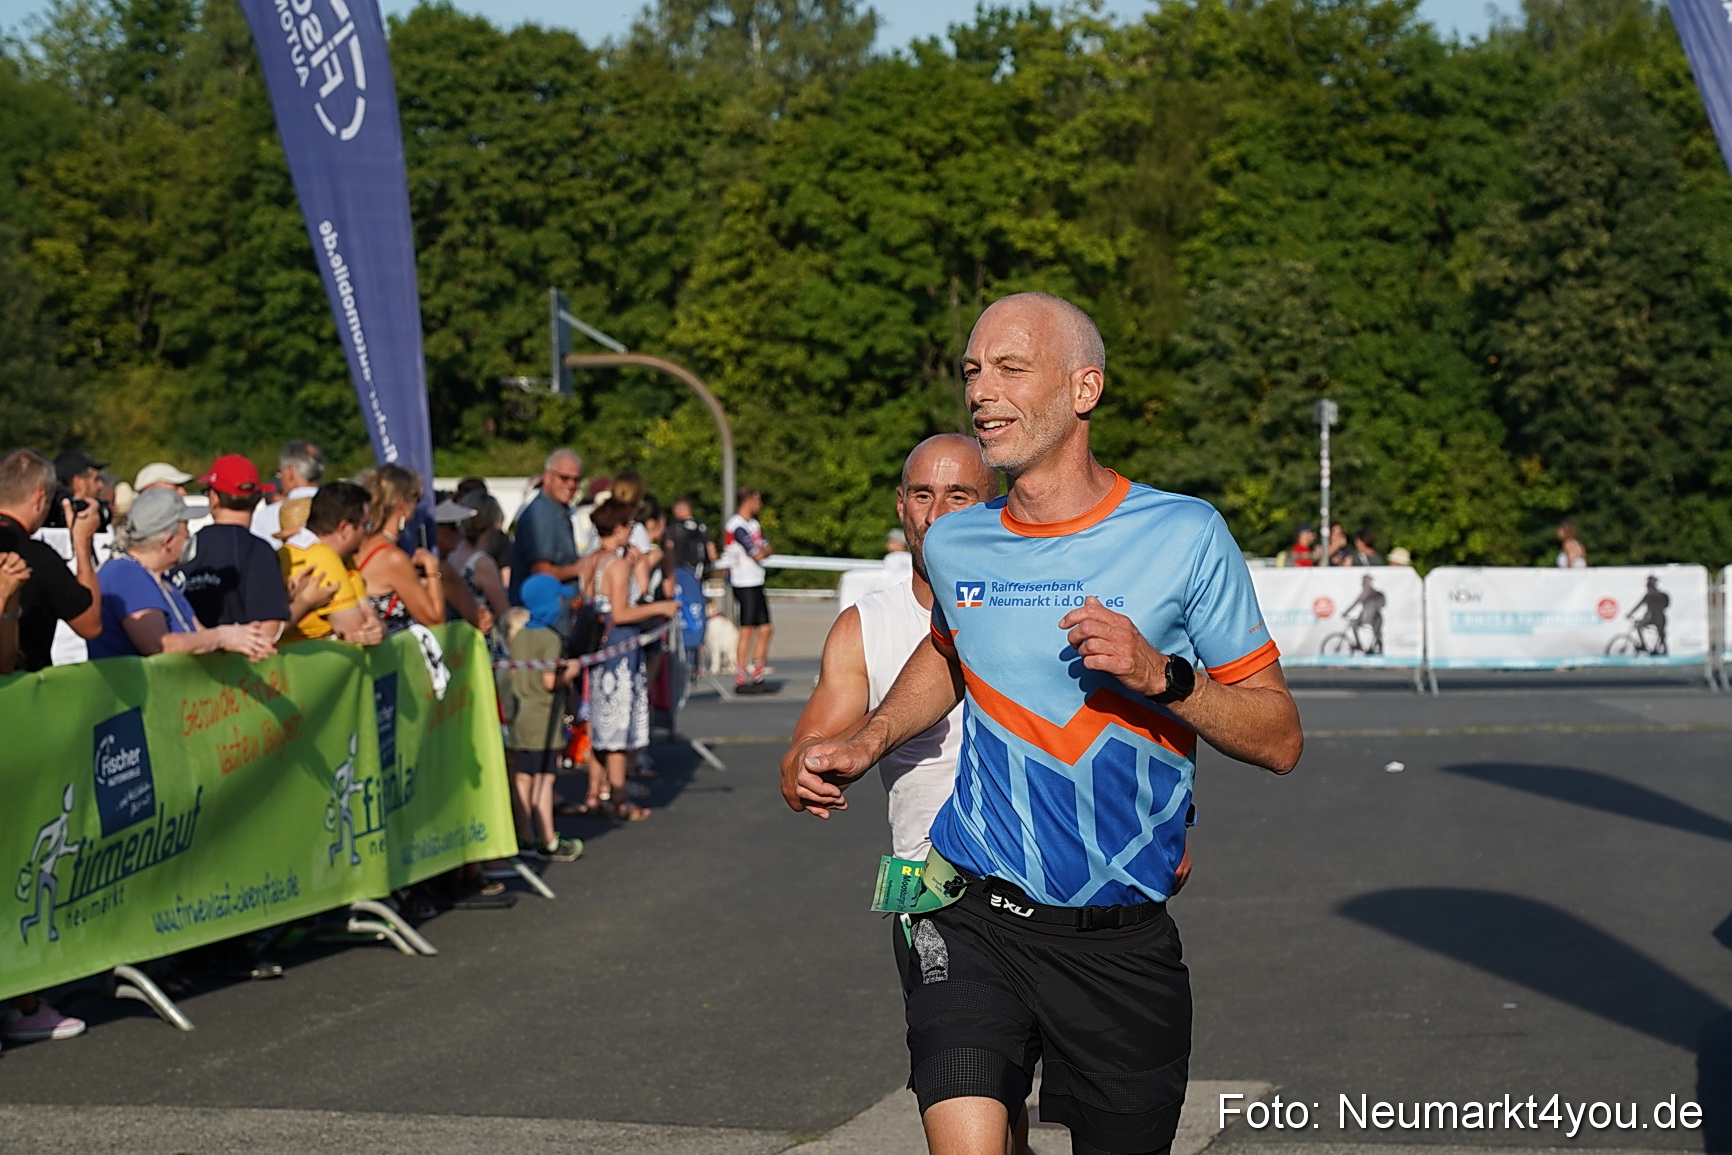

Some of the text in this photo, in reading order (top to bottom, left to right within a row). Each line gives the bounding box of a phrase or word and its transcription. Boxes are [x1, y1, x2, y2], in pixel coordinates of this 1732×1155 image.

[988, 594, 1051, 607] Neumarkt
[1105, 596, 1124, 608] eG
[991, 580, 1085, 593] Raiffeisenbank
[101, 747, 142, 778] Fischer
[69, 785, 204, 902] firmenlauf
[65, 885, 126, 930] neumarkt
